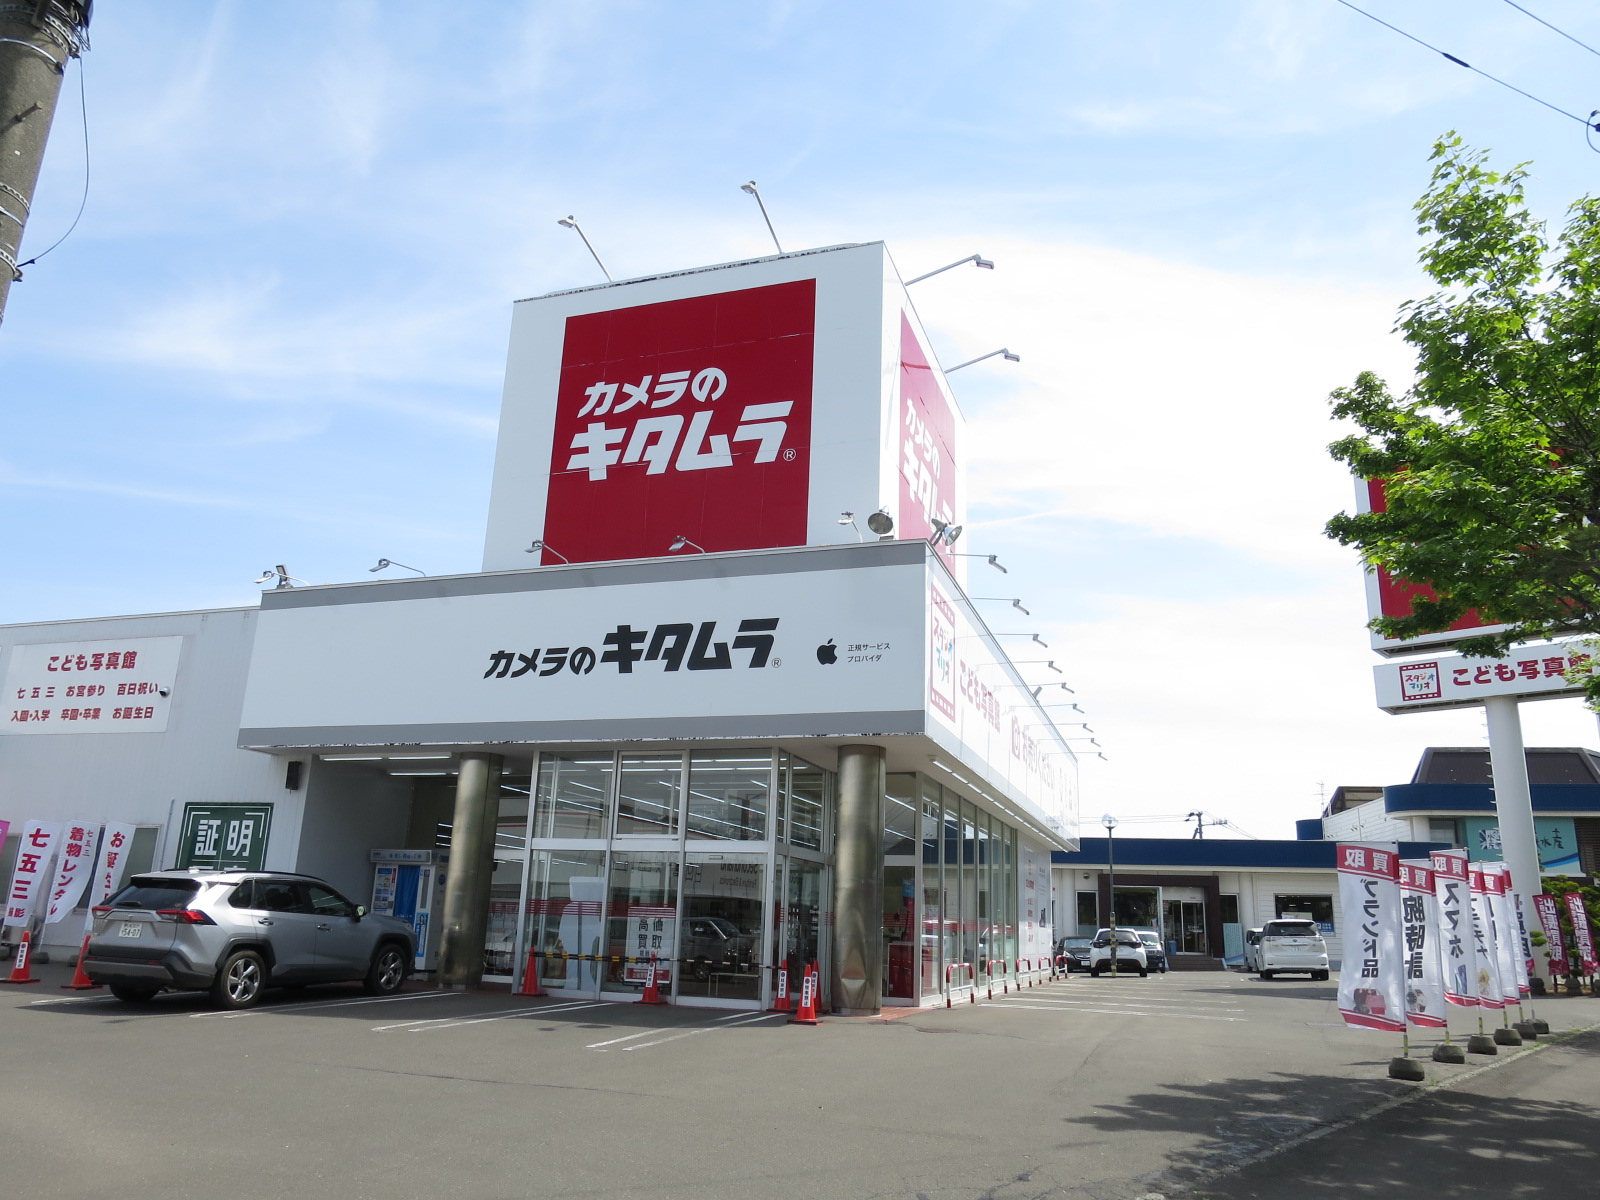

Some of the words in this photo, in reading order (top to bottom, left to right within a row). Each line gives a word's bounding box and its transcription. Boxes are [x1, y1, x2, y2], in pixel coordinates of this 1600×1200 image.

[576, 367, 728, 418] カメラの
[565, 400, 795, 481] キタムラ
[483, 646, 596, 680] カメラの
[600, 617, 781, 674] キタムラ
[847, 642, 892, 653] 正規サービス
[47, 651, 138, 672] こども写真館
[847, 654, 883, 664] プロバイダ
[1404, 672, 1436, 684] スタジオ
[1409, 680, 1431, 692] マリオ
[65, 685, 106, 698] お宮参り
[117, 682, 158, 696] 百日祝い
[112, 706, 154, 720] お誕生日
[194, 819, 254, 857] 証明
[12, 827, 51, 900] 七五三
[638, 934, 662, 949] 買取
